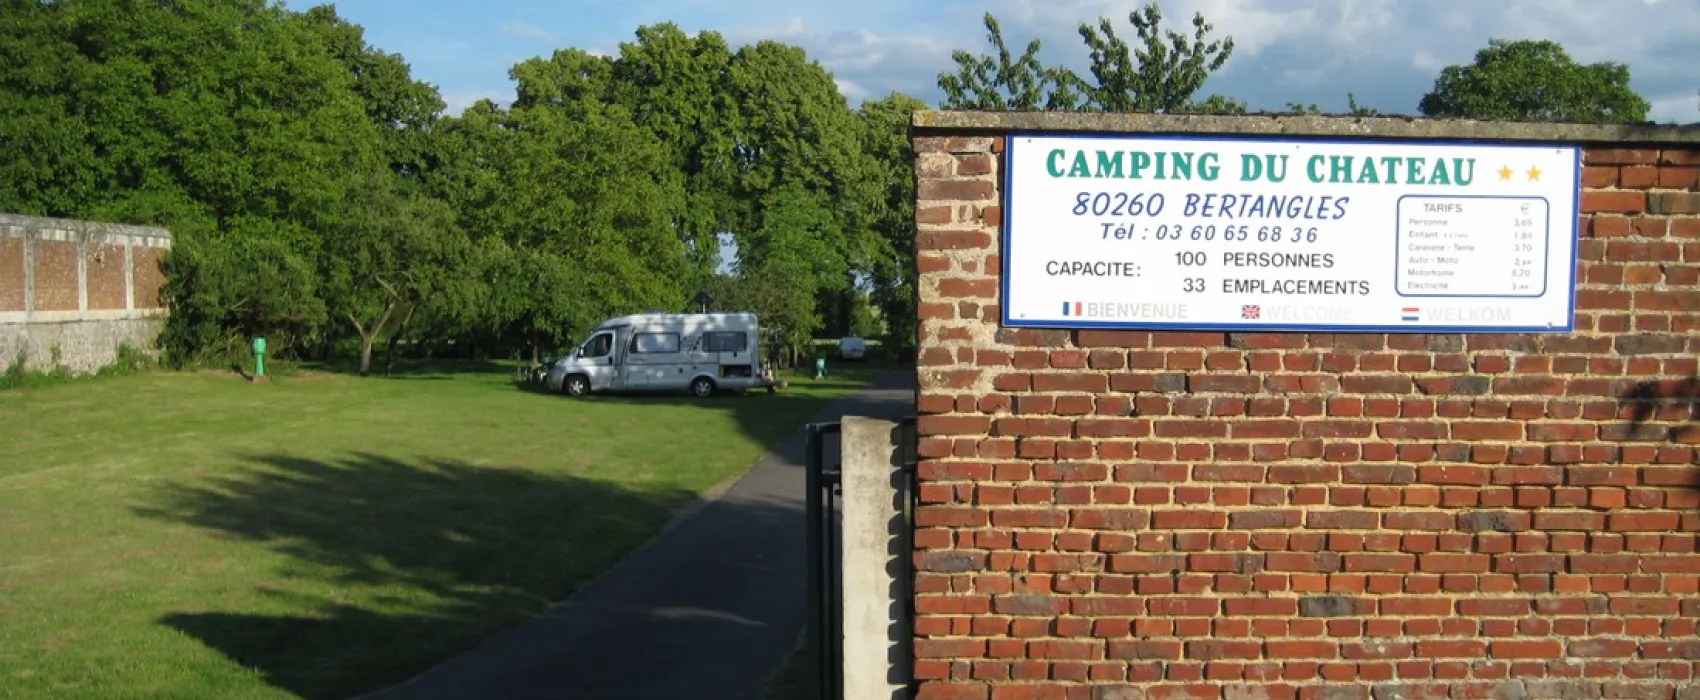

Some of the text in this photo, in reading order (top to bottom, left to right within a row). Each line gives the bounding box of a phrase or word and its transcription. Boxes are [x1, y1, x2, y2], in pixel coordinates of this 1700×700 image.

[1046, 149, 1476, 186] CAMPING DU CHATEAU
[1072, 192, 1349, 220] 80260 BERTANGLES
[1424, 202, 1463, 213] TARIFS
[1408, 218, 1448, 226] Personne
[1102, 223, 1134, 240] Tél
[1156, 225, 1182, 240] 03
[1190, 225, 1215, 240] 60
[1224, 225, 1248, 241] 65
[1258, 226, 1281, 242] 68
[1291, 227, 1317, 243] 36
[1175, 251, 1334, 268] 100 PERSONNES
[1436, 256, 1458, 264] Moto
[1046, 261, 1140, 276] CAPACITE:
[1183, 278, 1369, 295] 33 EMPLACEMENTS
[1087, 302, 1188, 319] BIENVENUE
[1266, 305, 1354, 321] WELCOME
[1427, 306, 1511, 322] WELKOM
